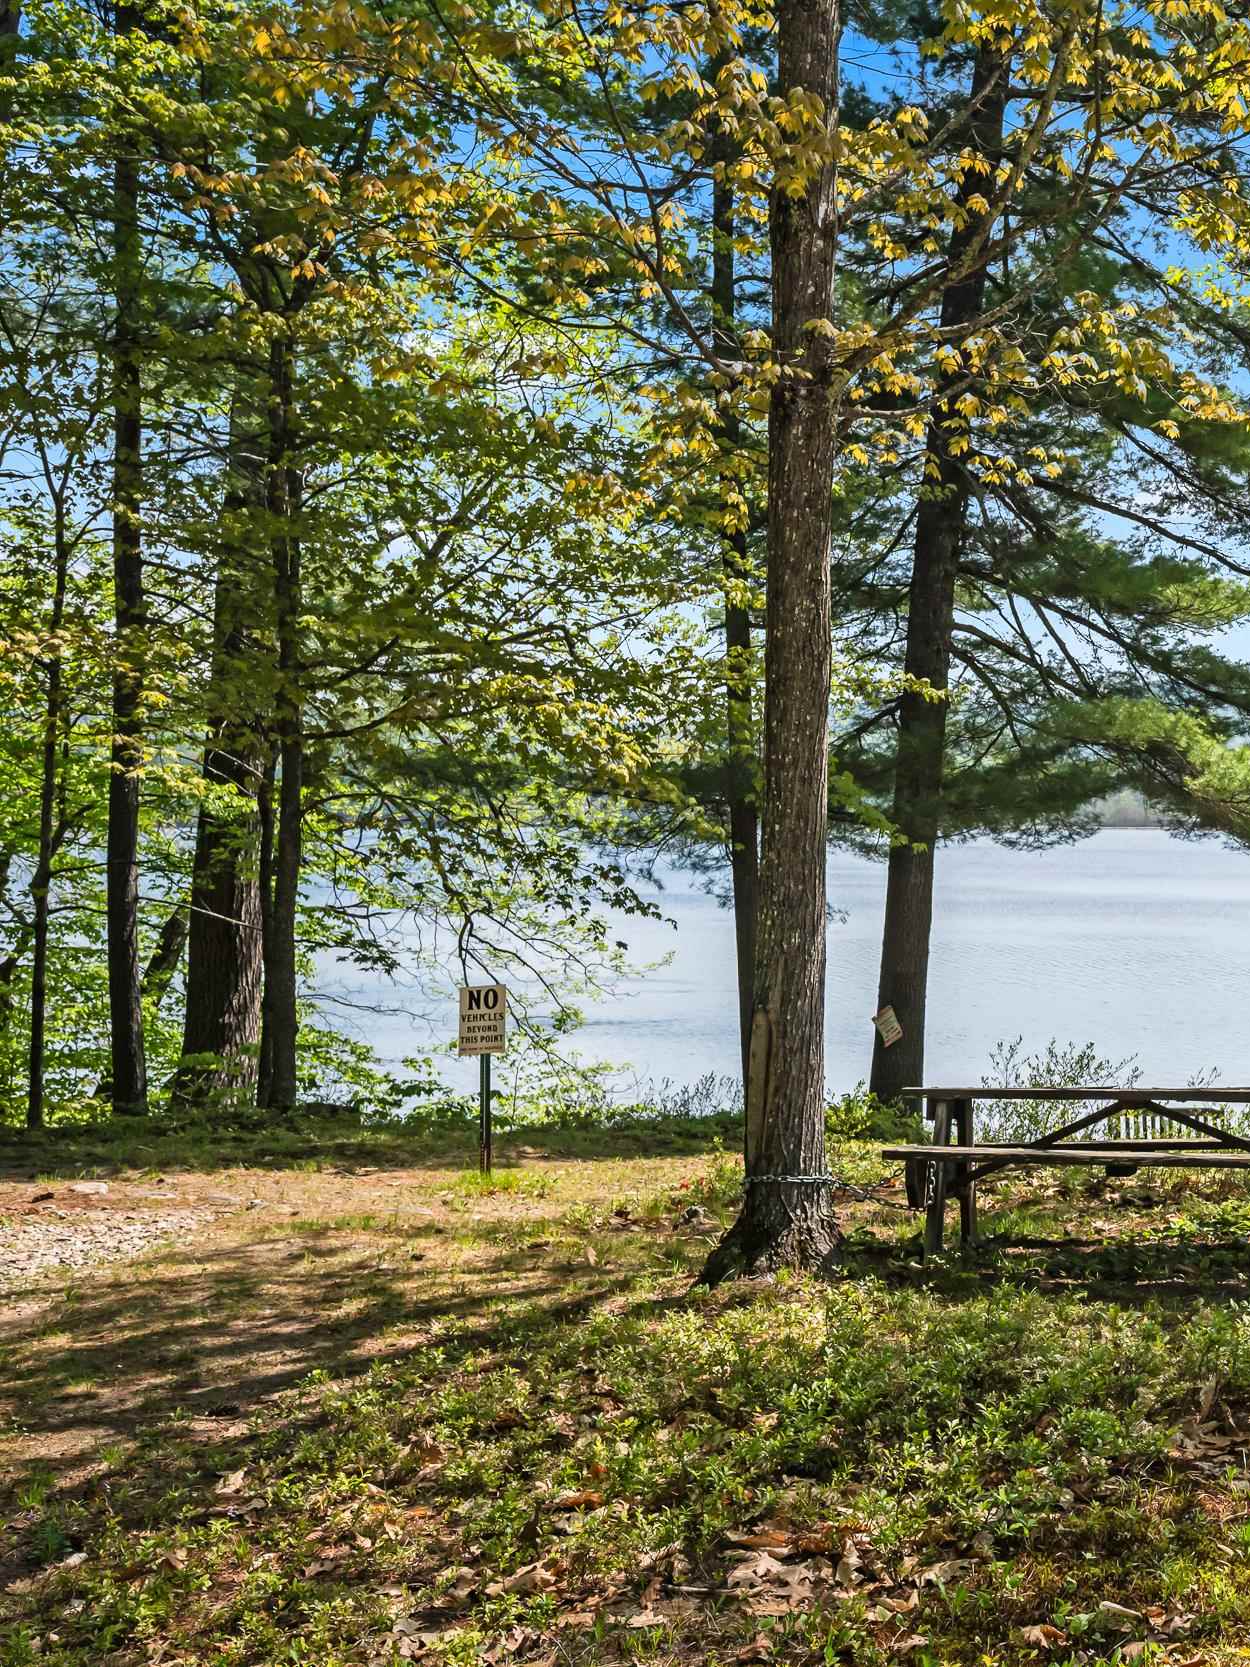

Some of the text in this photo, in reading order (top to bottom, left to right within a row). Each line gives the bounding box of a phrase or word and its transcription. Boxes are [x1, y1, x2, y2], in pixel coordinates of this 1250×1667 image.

[468, 988, 498, 1010] NO
[461, 1012, 504, 1022] VEHICLES
[467, 1024, 498, 1033] BEYOND
[461, 1034, 504, 1044] THIS POINT
